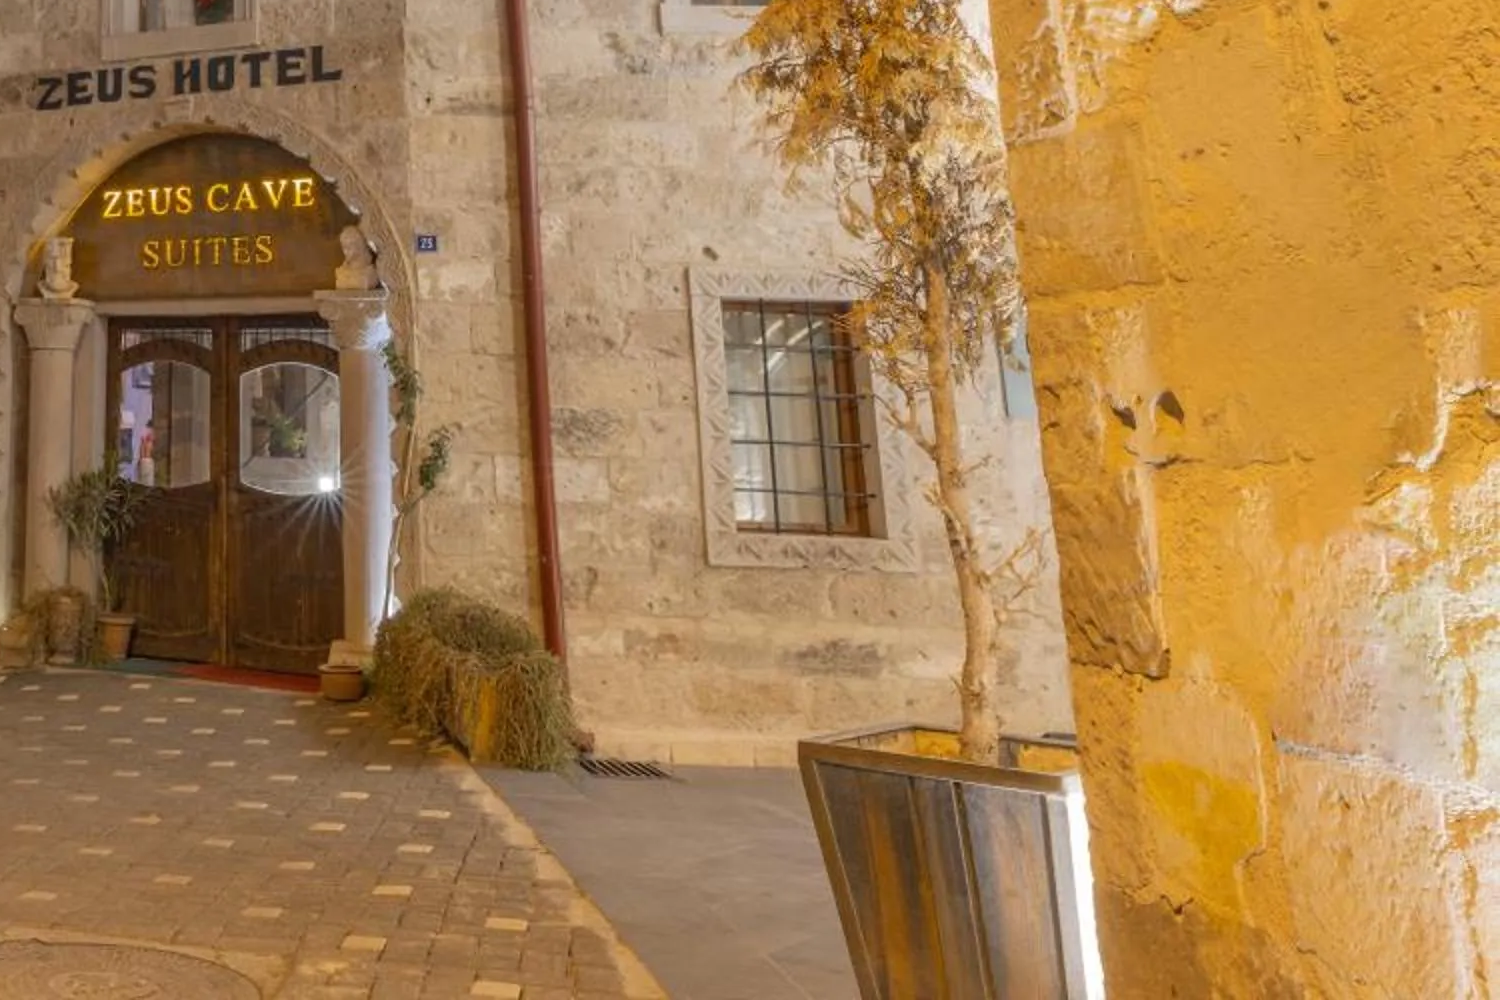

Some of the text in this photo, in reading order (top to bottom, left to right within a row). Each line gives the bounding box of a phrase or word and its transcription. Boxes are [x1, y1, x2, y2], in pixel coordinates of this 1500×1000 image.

[36, 45, 342, 111] ZEUS HOTEL
[102, 177, 315, 219] ZEUS CAVE
[142, 234, 275, 269] SUITES
